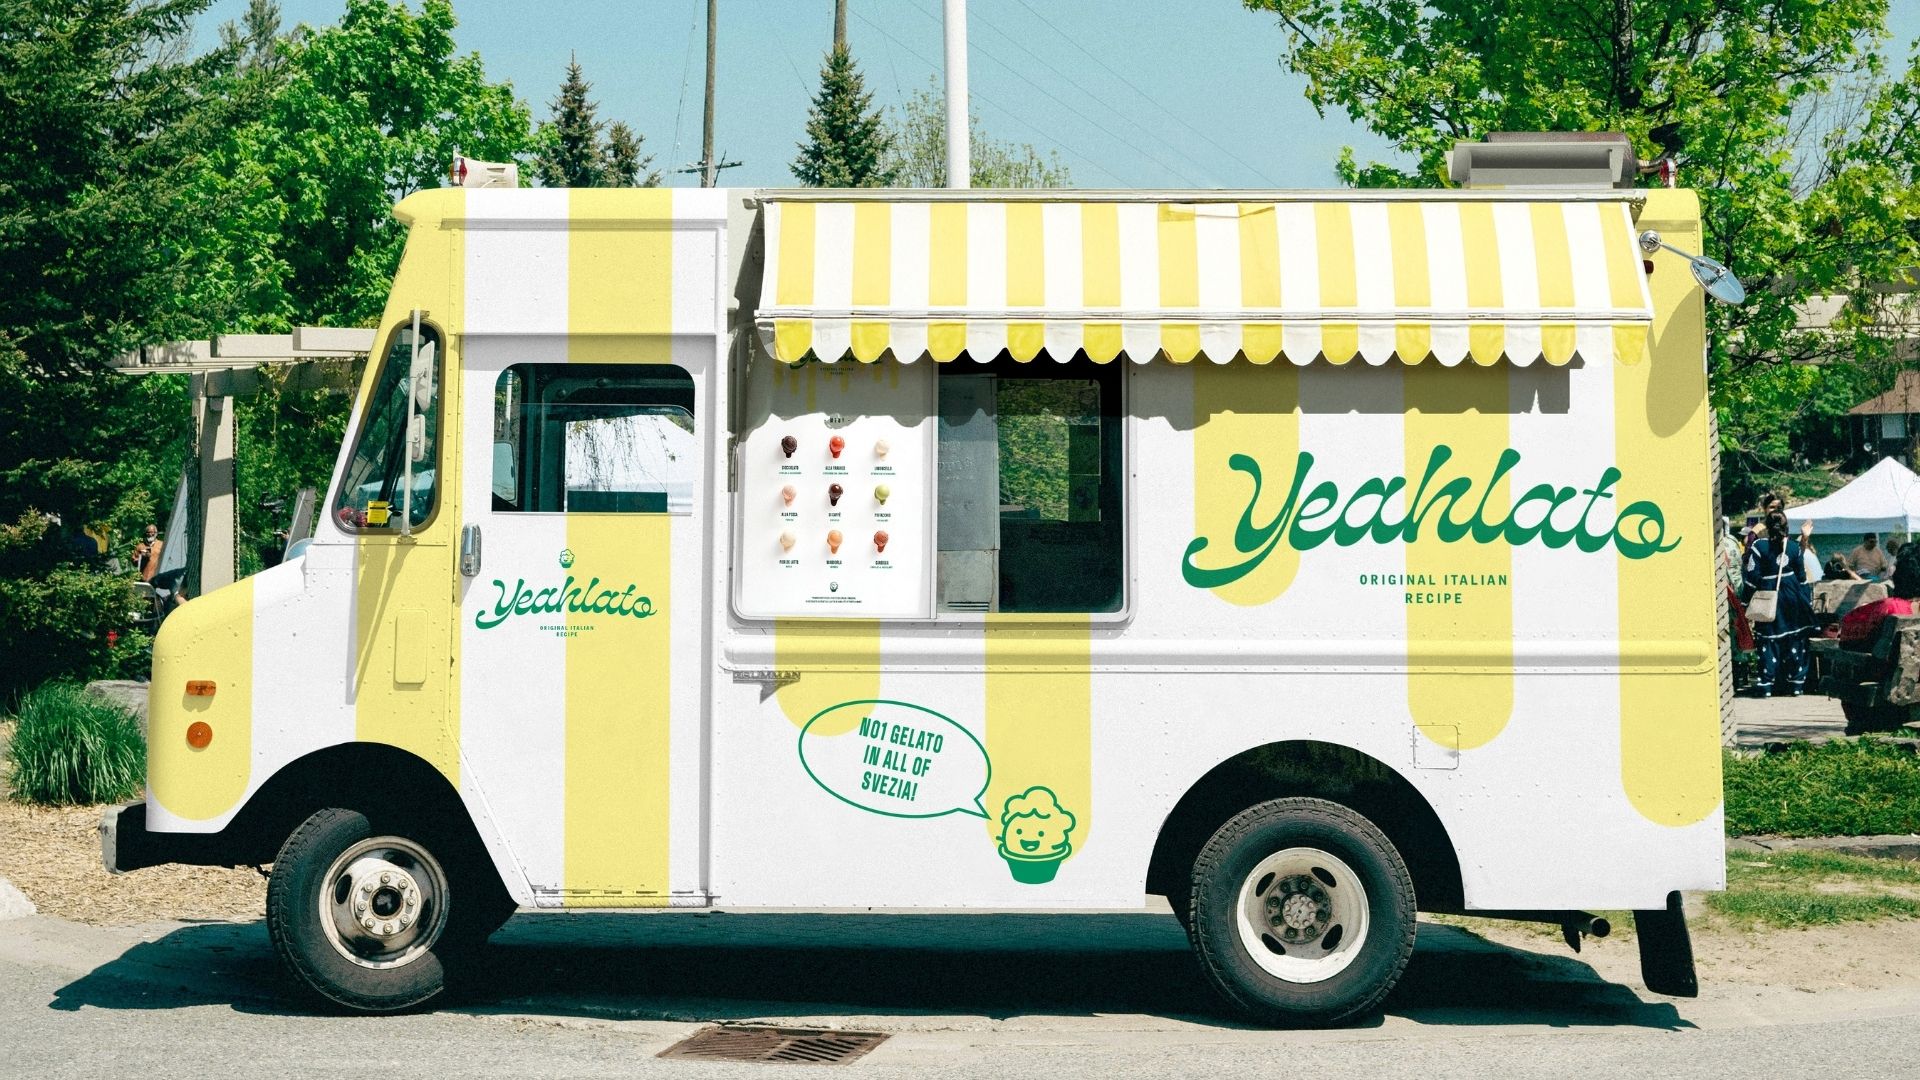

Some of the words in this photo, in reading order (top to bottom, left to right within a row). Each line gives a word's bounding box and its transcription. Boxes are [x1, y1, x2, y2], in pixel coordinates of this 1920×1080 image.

[1182, 445, 1680, 588] Yeahlato
[1359, 574, 1437, 586] ORIGINAL
[1444, 574, 1508, 586] ITALIAN
[475, 576, 658, 630] Yeahlato
[1404, 592, 1463, 604] RECIPE
[859, 717, 888, 741] NO1
[890, 725, 944, 754] GELATO
[863, 745, 881, 766] IN
[882, 749, 907, 773] ALL
[912, 756, 932, 777] OF
[861, 771, 918, 802] SVEZIA!
